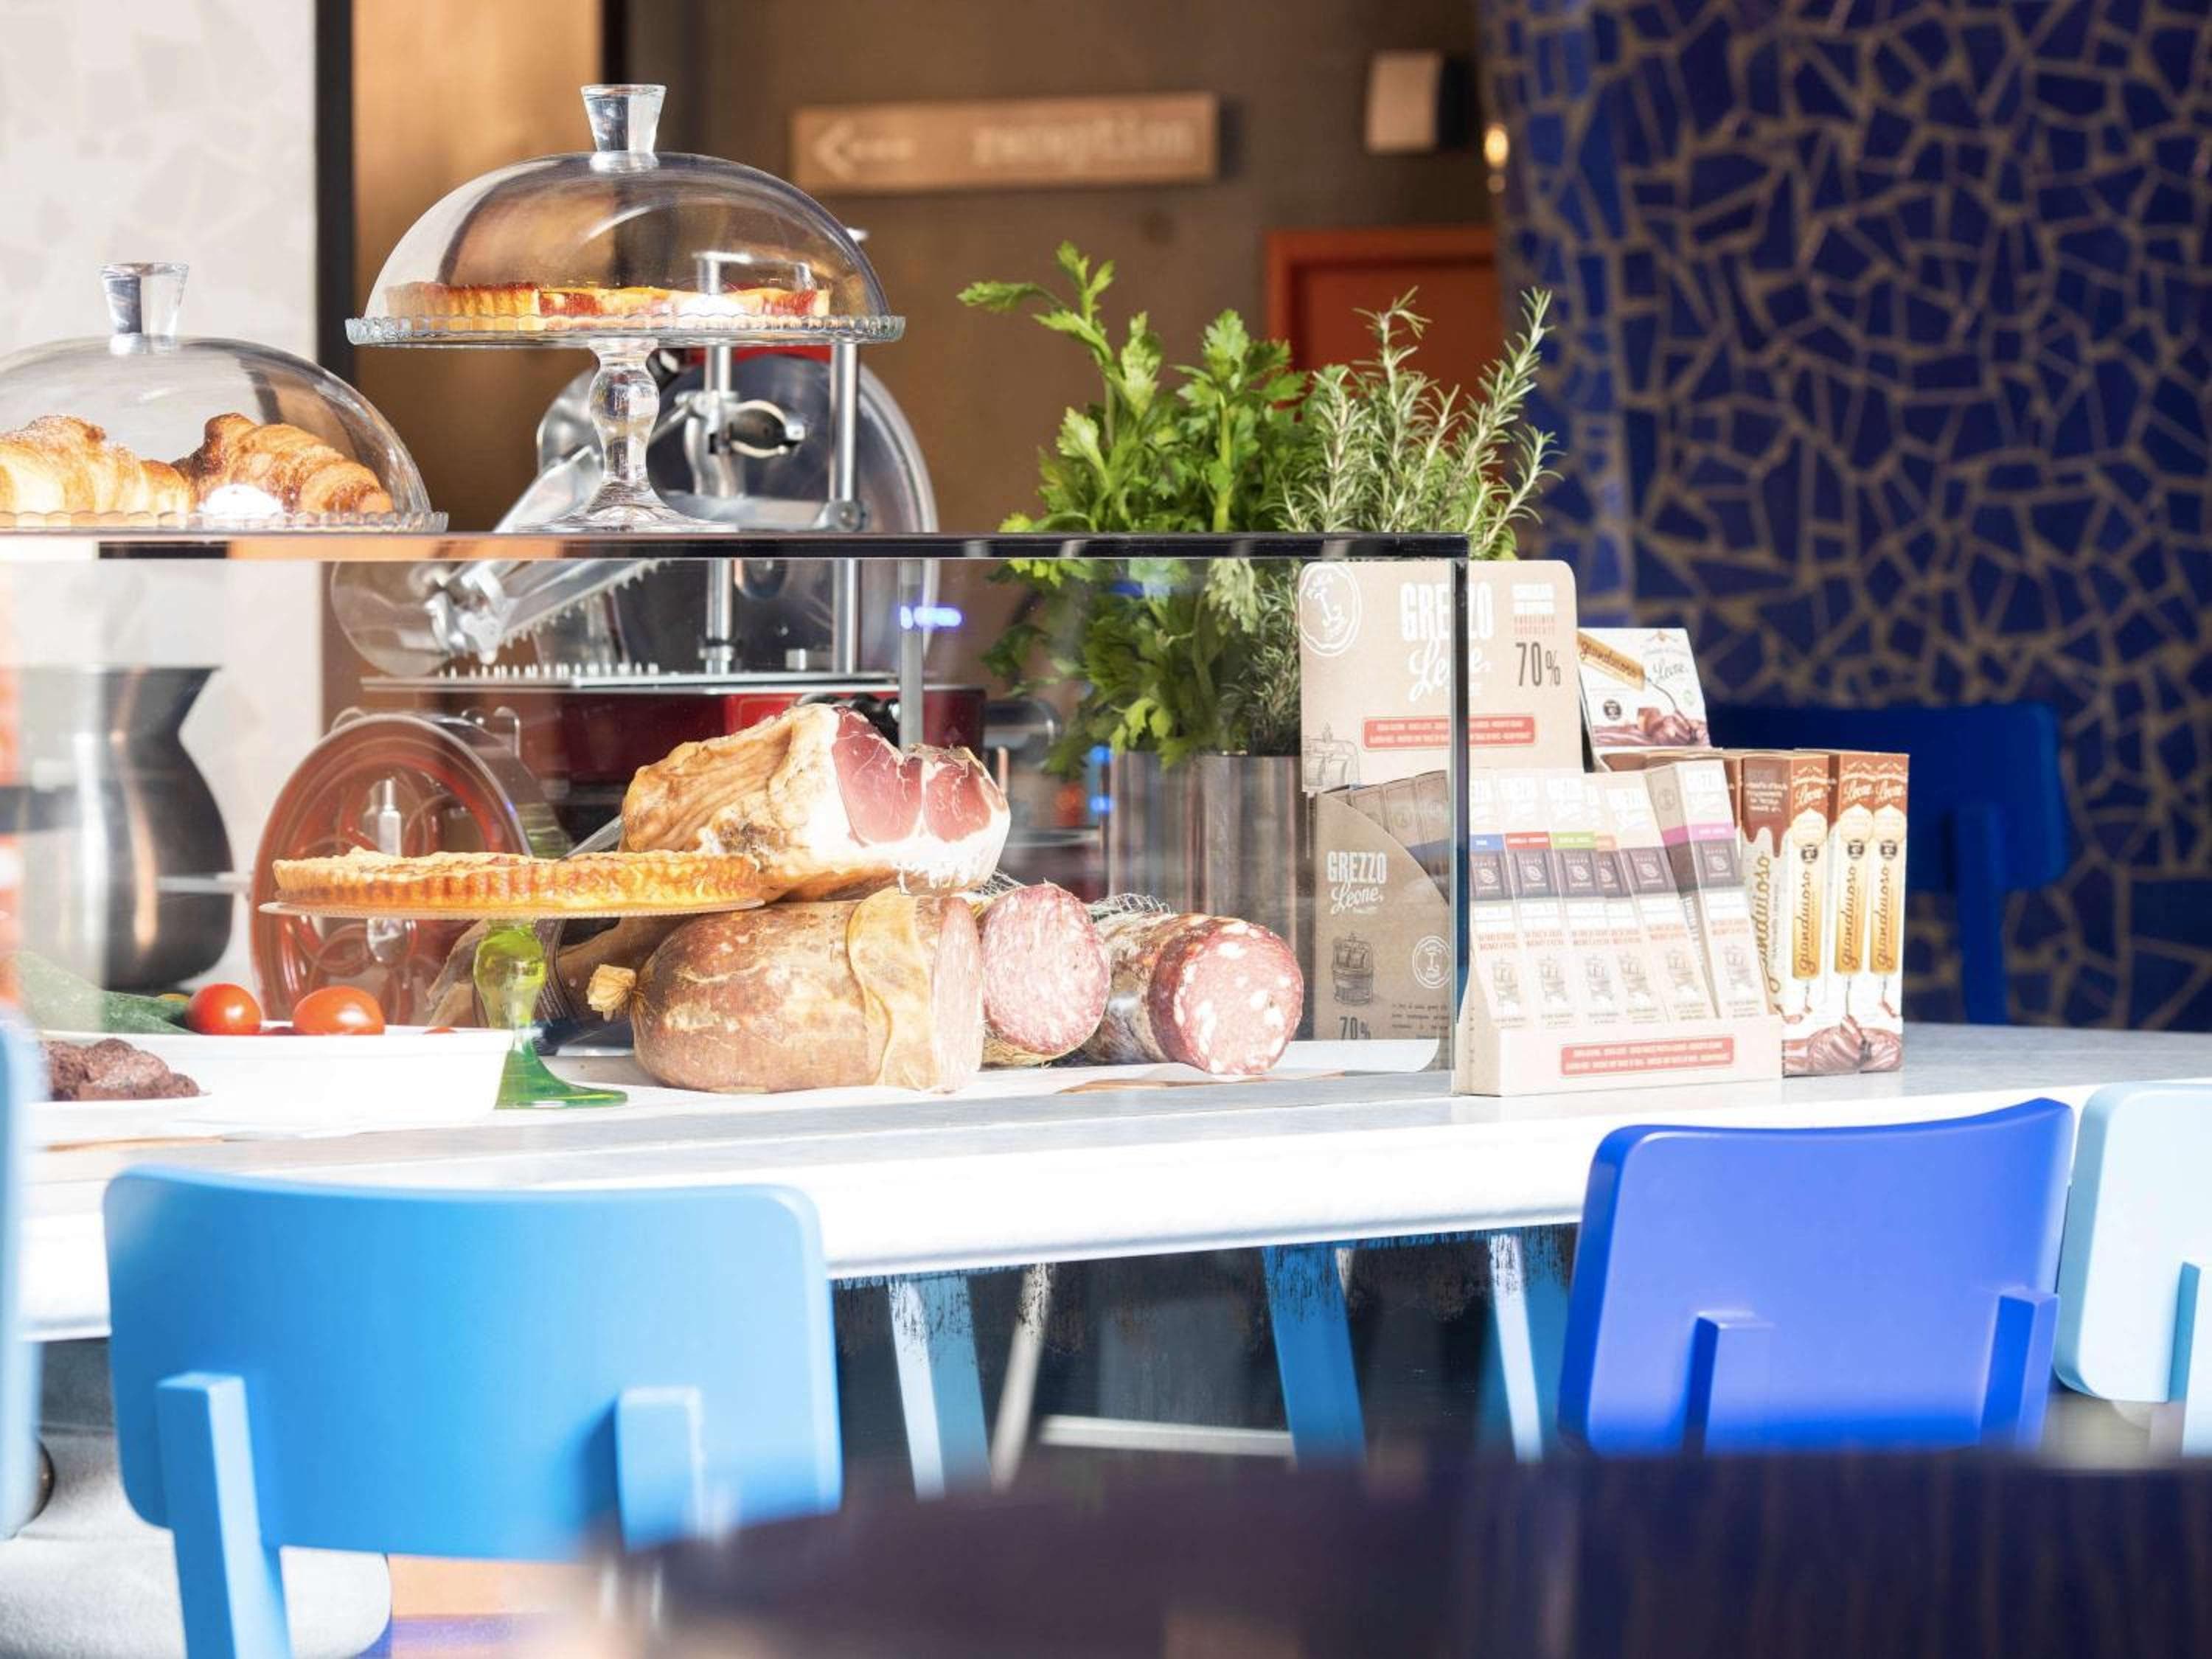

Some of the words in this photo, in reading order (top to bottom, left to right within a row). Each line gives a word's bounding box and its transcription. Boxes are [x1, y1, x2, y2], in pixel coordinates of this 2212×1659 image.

[1400, 582, 1493, 641] GREZO
[1515, 641, 1561, 687] 70%
[1327, 850, 1386, 885] GREZZO
[1340, 1016, 1371, 1040] 70%
